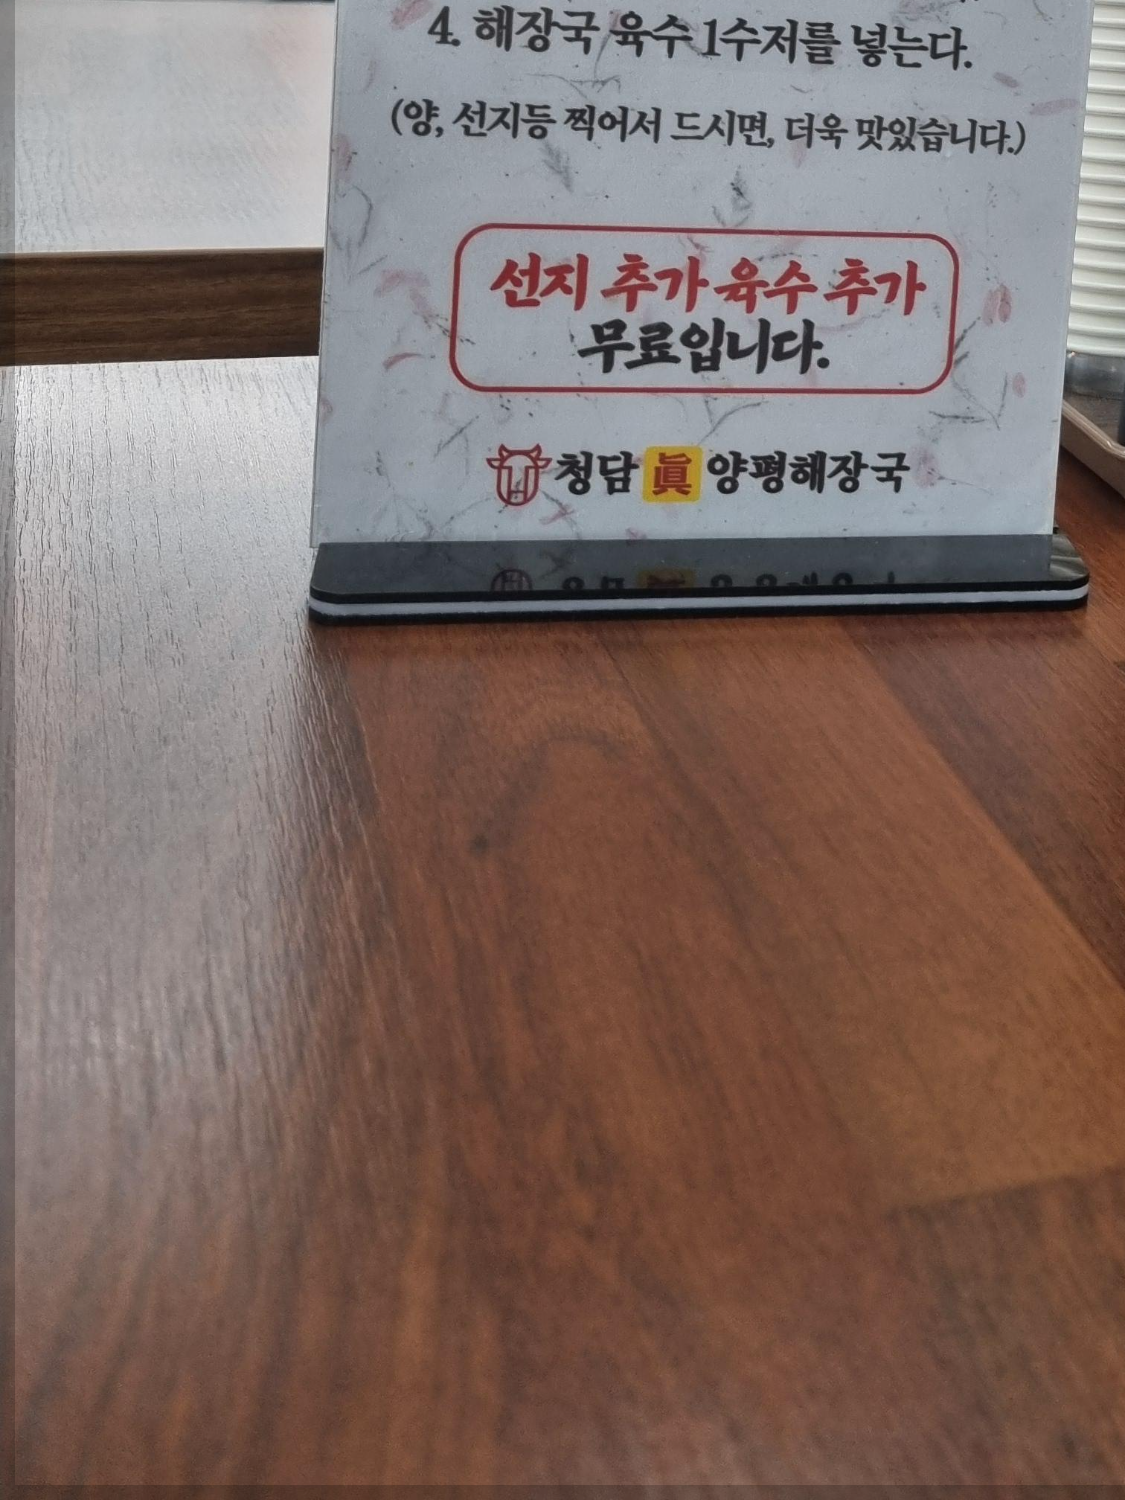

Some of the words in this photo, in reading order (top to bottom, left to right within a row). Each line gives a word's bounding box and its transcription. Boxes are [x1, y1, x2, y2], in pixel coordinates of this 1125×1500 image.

[428, 6, 460, 46] 4.
[473, 5, 600, 55] 해장국
[609, 11, 694, 58] 육수
[701, 18, 841, 65] 1수저를
[851, 23, 972, 70] 넣는다.
[392, 99, 443, 137] (양,
[453, 101, 556, 139] 선지등
[564, 105, 661, 143] 찍어서
[671, 110, 774, 148] 드시면,
[785, 113, 848, 149] 더욱
[856, 115, 1025, 155] 맛있습니다.)
[490, 253, 588, 311] 선지
[601, 254, 709, 312] 추가
[714, 257, 818, 314] 육수
[824, 258, 926, 315] 추가
[577, 318, 829, 374] 무료입니다.
[555, 451, 639, 495] 청담
[707, 451, 910, 494] 양평해장국
